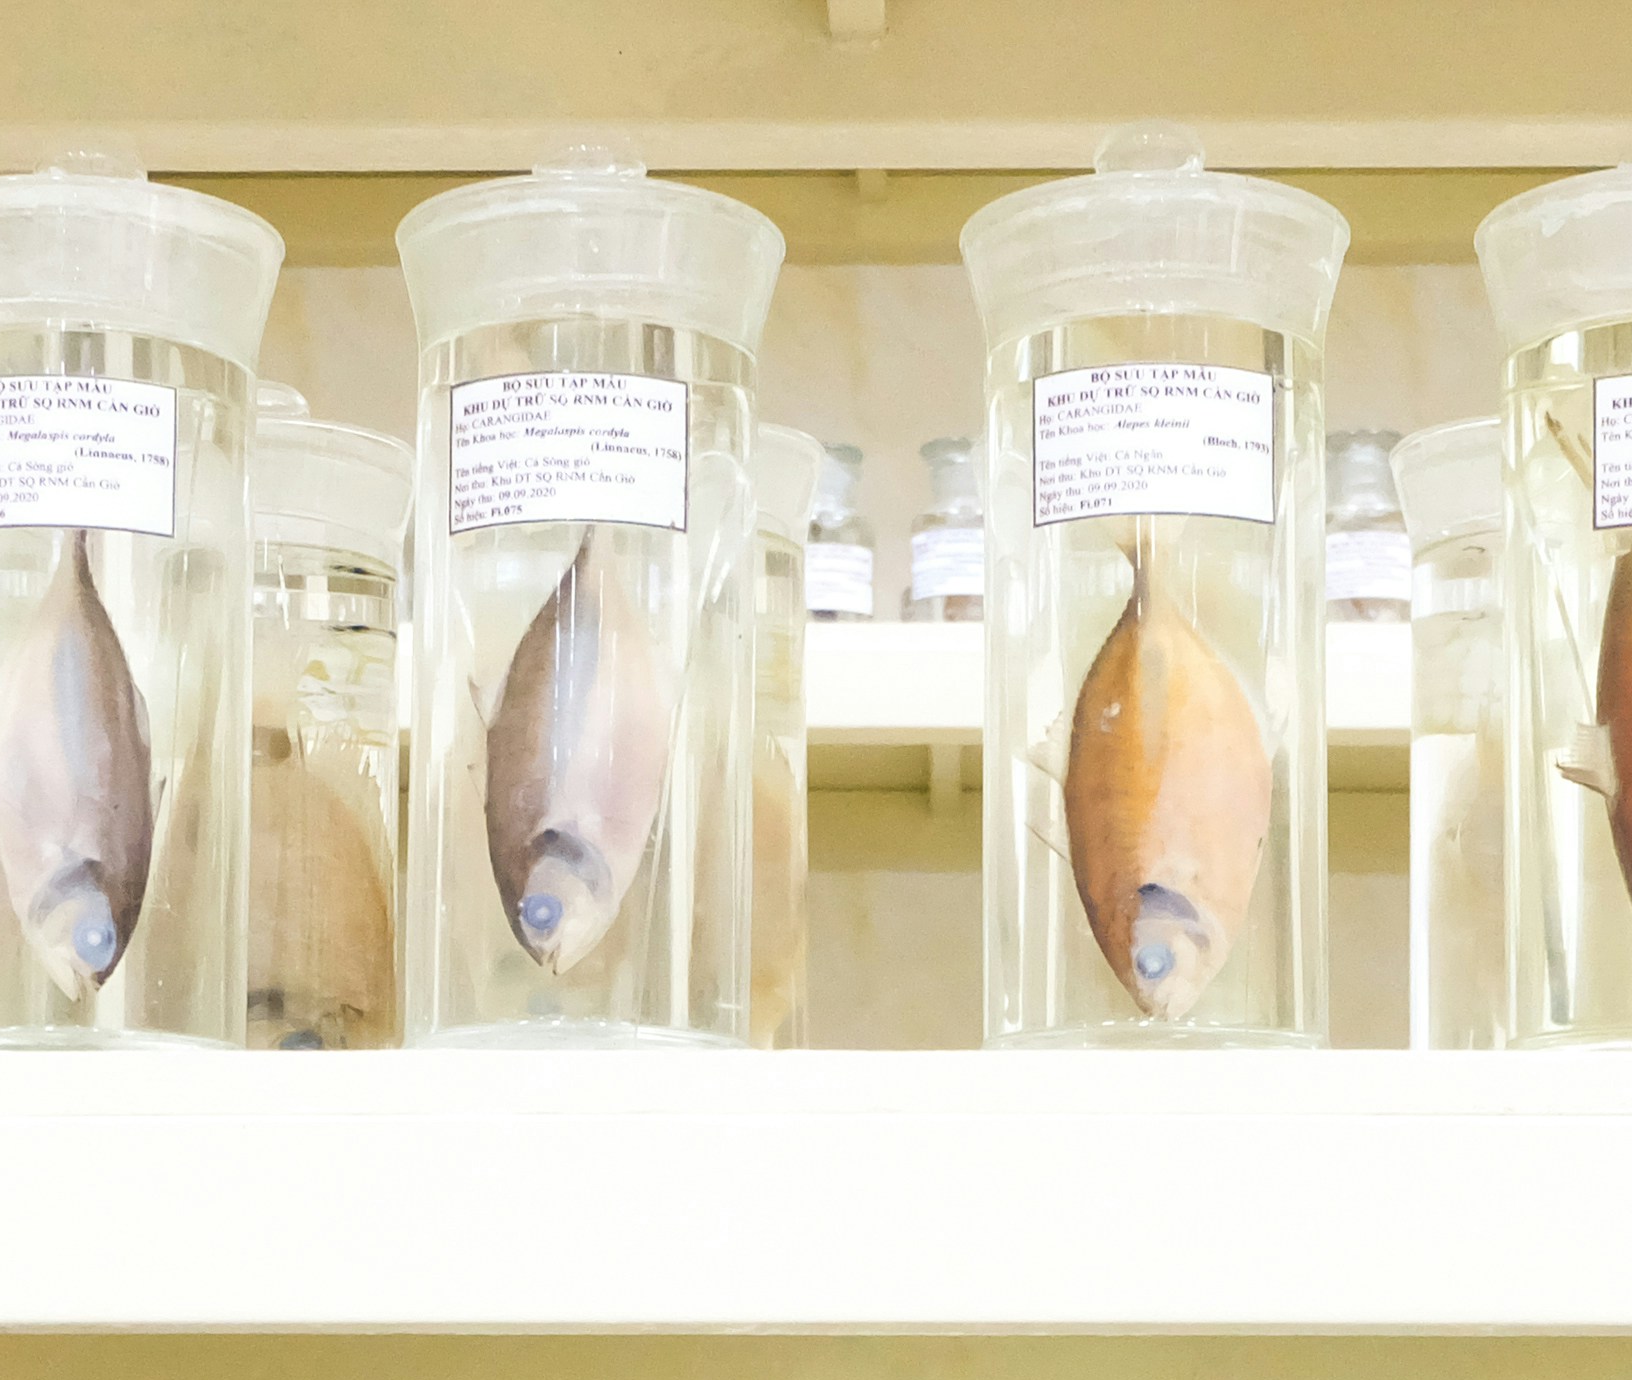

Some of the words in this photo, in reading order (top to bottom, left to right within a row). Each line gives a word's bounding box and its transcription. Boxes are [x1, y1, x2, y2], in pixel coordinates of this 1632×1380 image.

[33, 397, 53, 408] SQ
[57, 399, 91, 409] RNM
[1048, 395, 1075, 408] KHU
[1141, 387, 1159, 398] SQ
[1166, 387, 1198, 396] RNM
[464, 403, 488, 416] KHU
[550, 396, 568, 406] SQ
[573, 395, 607, 405] RNM
[1058, 404, 1141, 422] CARANGIDAE
[472, 411, 551, 429] CARANGIDAE
[73, 432, 115, 443] cordyla
[589, 429, 630, 438] cordyla
[1127, 466, 1143, 476] SQ
[1148, 465, 1178, 475] RNM
